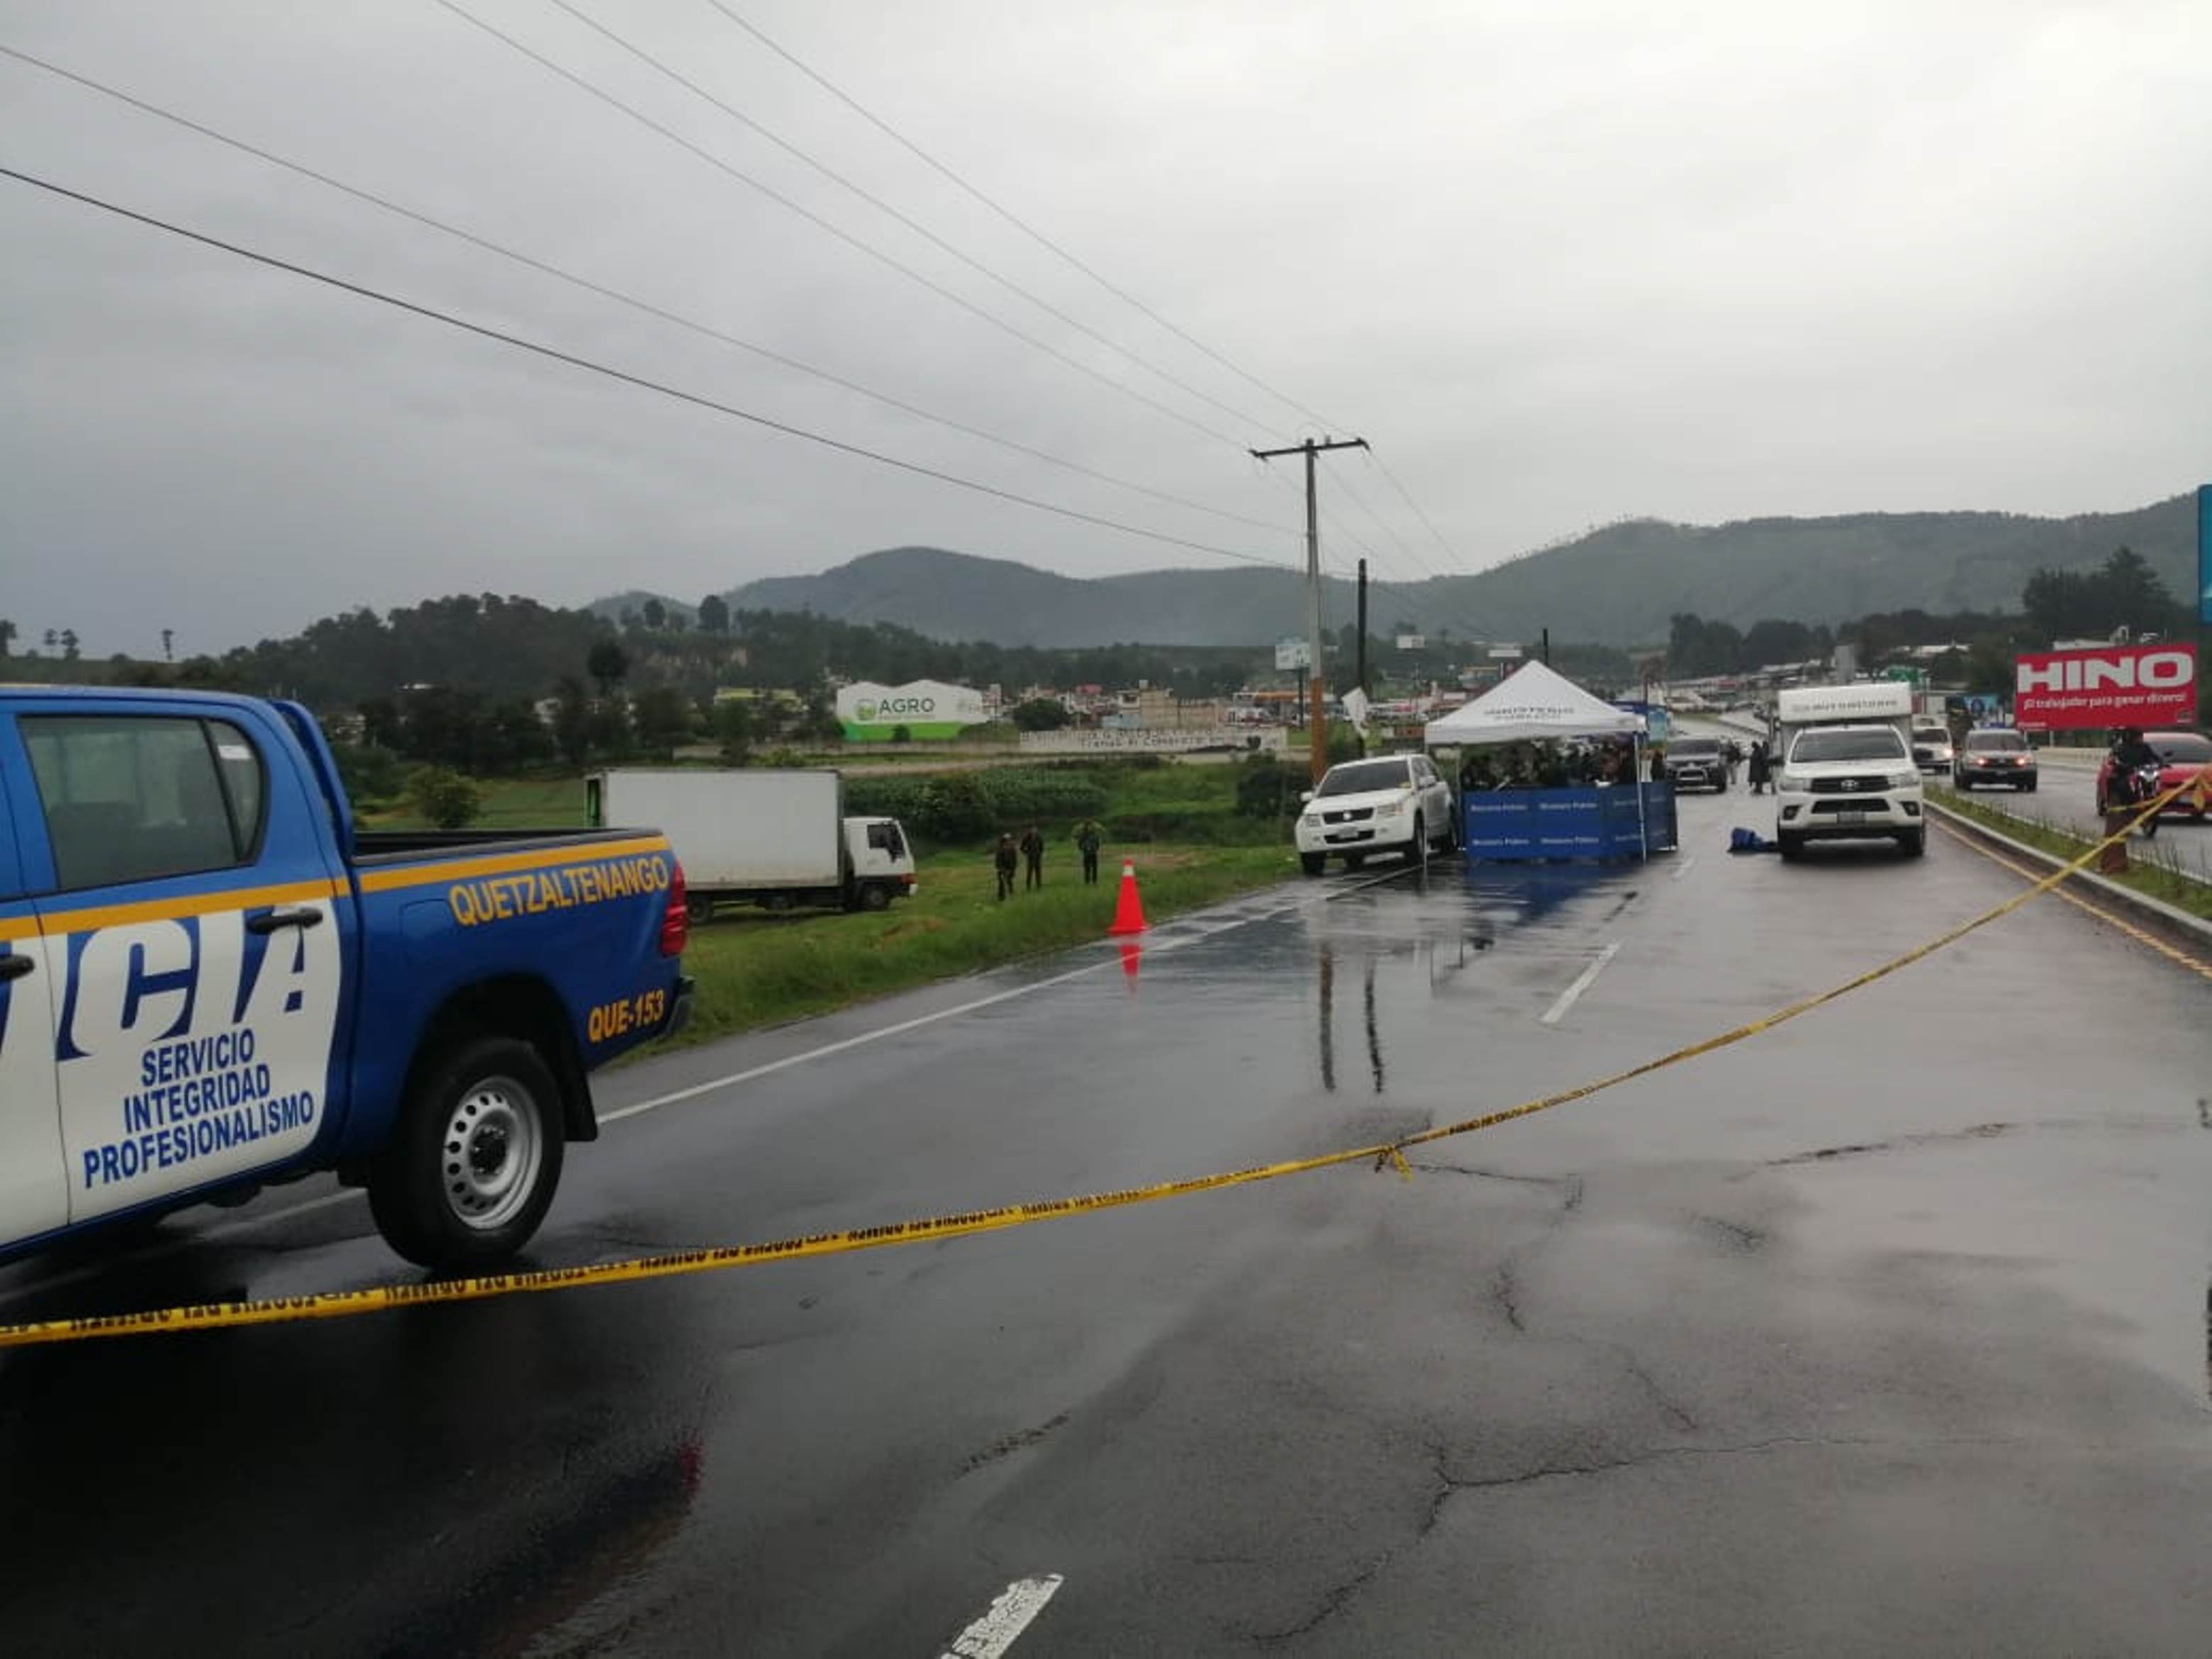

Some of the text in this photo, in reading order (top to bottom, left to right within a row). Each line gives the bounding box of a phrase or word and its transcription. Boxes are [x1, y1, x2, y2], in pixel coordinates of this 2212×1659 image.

[2018, 652, 2194, 693] HINO
[878, 698, 935, 714] AGRO
[2037, 698, 2088, 709] trabajador
[2090, 697, 2112, 710] para
[2114, 696, 2144, 708] ganar
[448, 856, 670, 927] QUETZALTENANGO
[588, 990, 664, 1044] QUE-153
[141, 1028, 255, 1087] SERVICIO
[123, 1063, 271, 1134] INTEGRIDAD
[83, 1090, 315, 1189] PROFESIONALISMO
